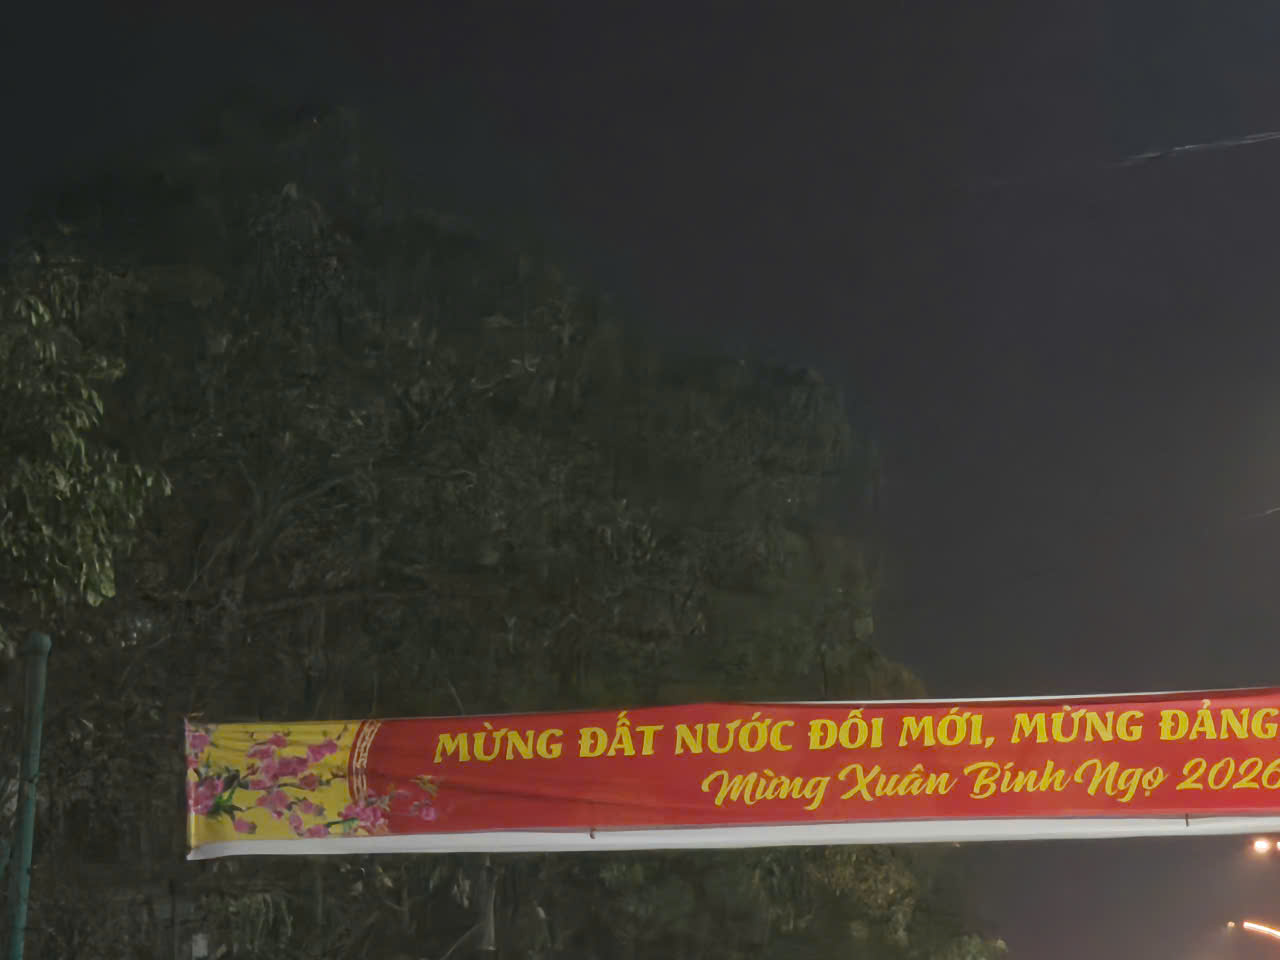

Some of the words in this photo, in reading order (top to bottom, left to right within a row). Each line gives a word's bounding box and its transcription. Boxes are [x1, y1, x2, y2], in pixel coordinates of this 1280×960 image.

[433, 721, 564, 763] MỪNG
[578, 710, 665, 758] ĐẤT
[674, 712, 795, 754] NƯỚC
[898, 706, 996, 749] MỚI,
[1010, 705, 1144, 744] MỪNG
[1158, 699, 1280, 741] ĐẢNG
[837, 763, 958, 802] Xuân
[963, 759, 1072, 800] Bính
[1073, 758, 1169, 803] Ngọ
